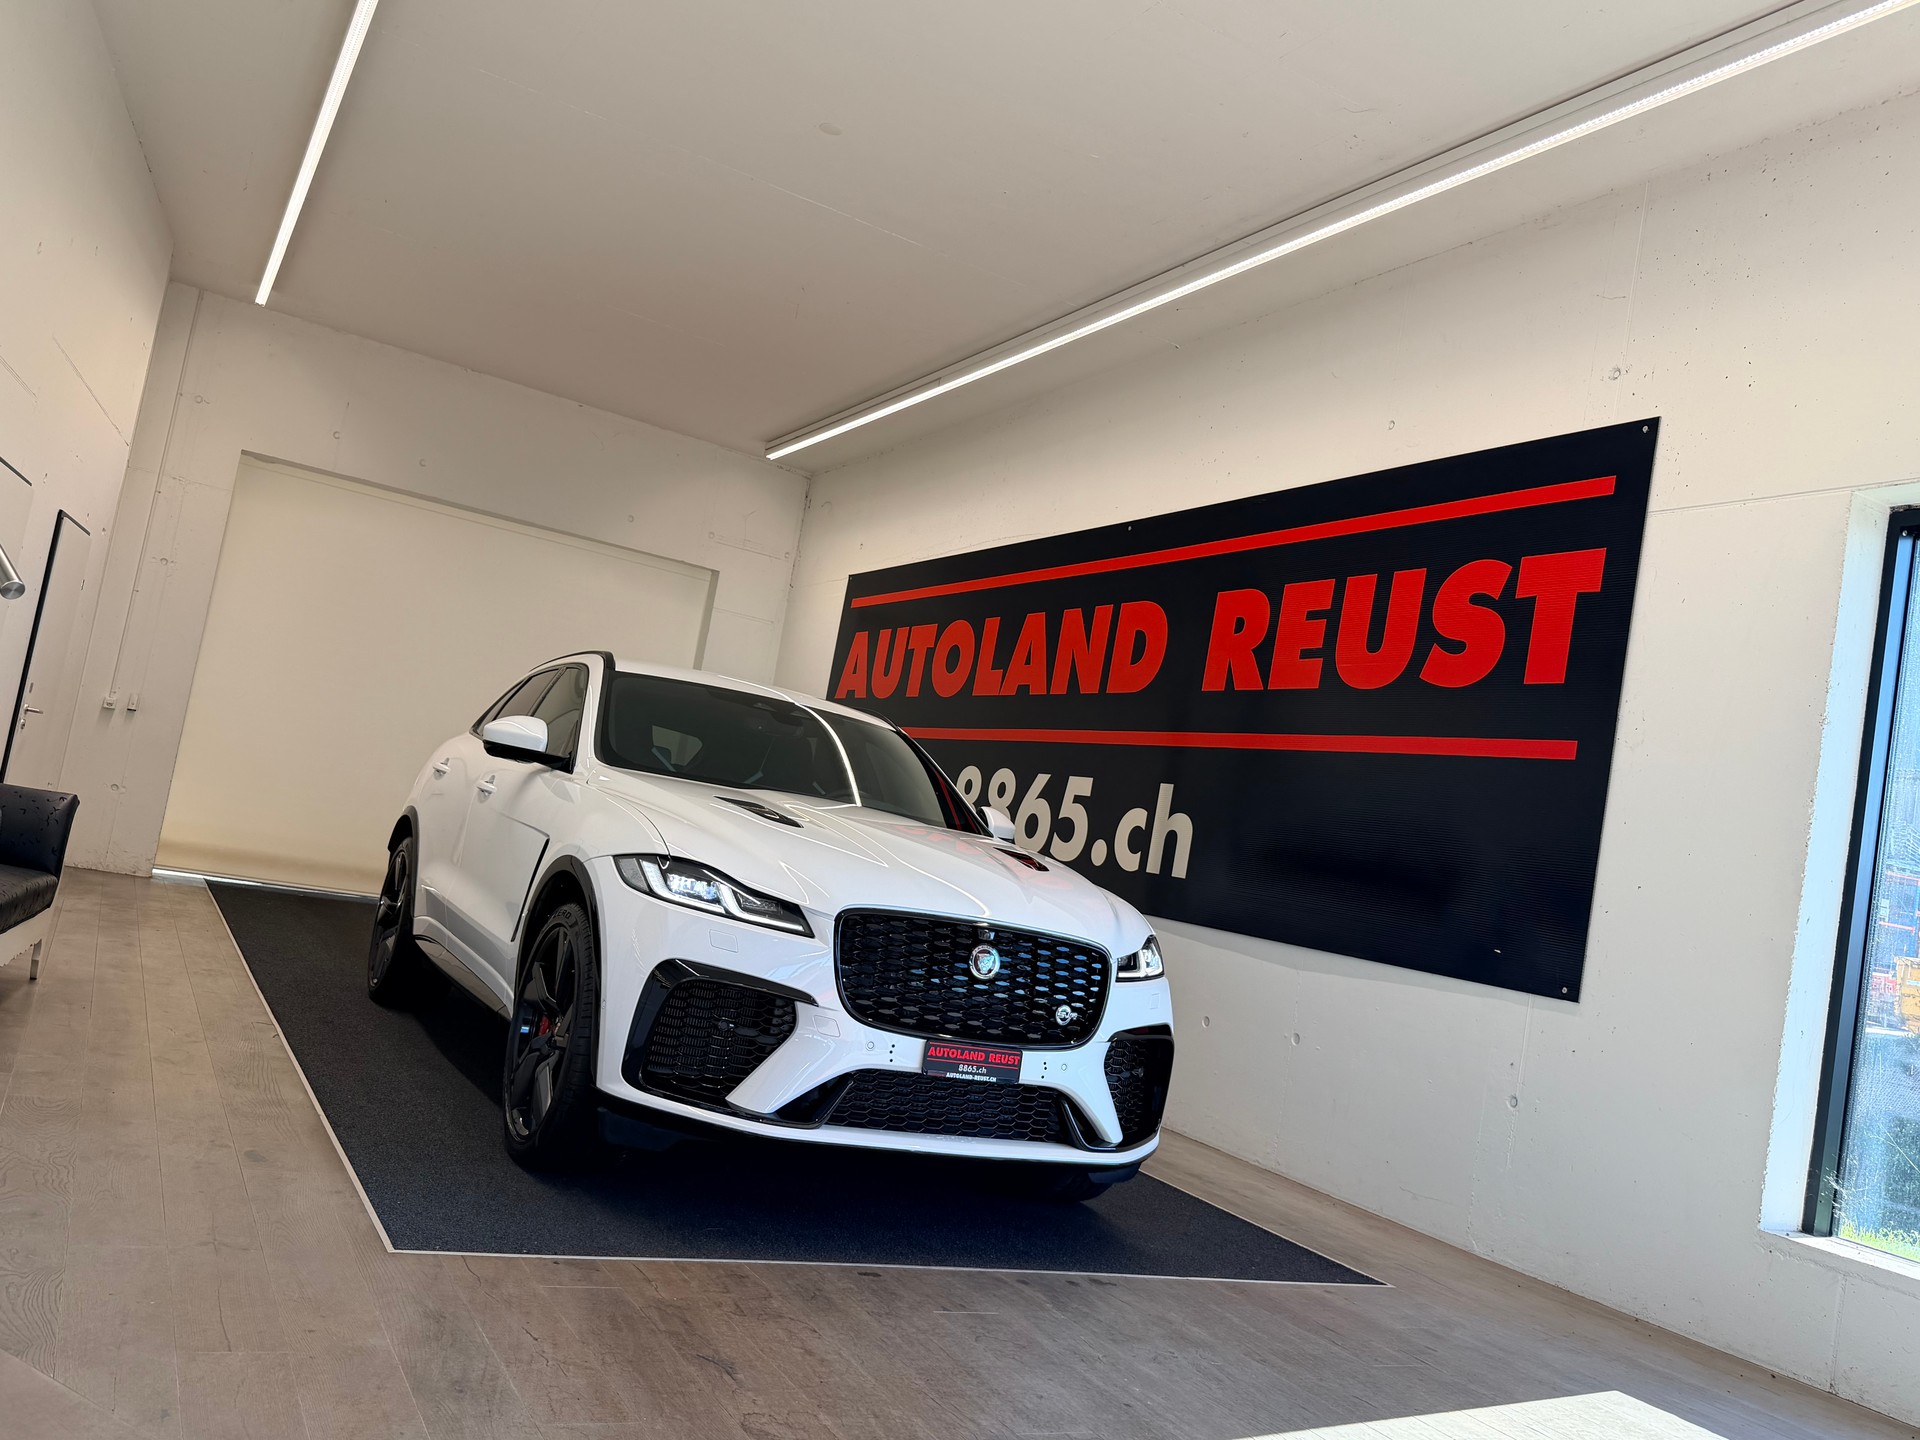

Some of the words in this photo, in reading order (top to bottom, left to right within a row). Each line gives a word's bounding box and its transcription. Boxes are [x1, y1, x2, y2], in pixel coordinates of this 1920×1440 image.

[834, 601, 1168, 699] AUTOLAND
[1201, 547, 1607, 691] REUST
[928, 1046, 985, 1061] AUTOLAND
[988, 1053, 1020, 1065] REUST
[958, 1064, 987, 1074] 8865.ch
[946, 1072, 997, 1083] AUTOLAND-REUST.CH
